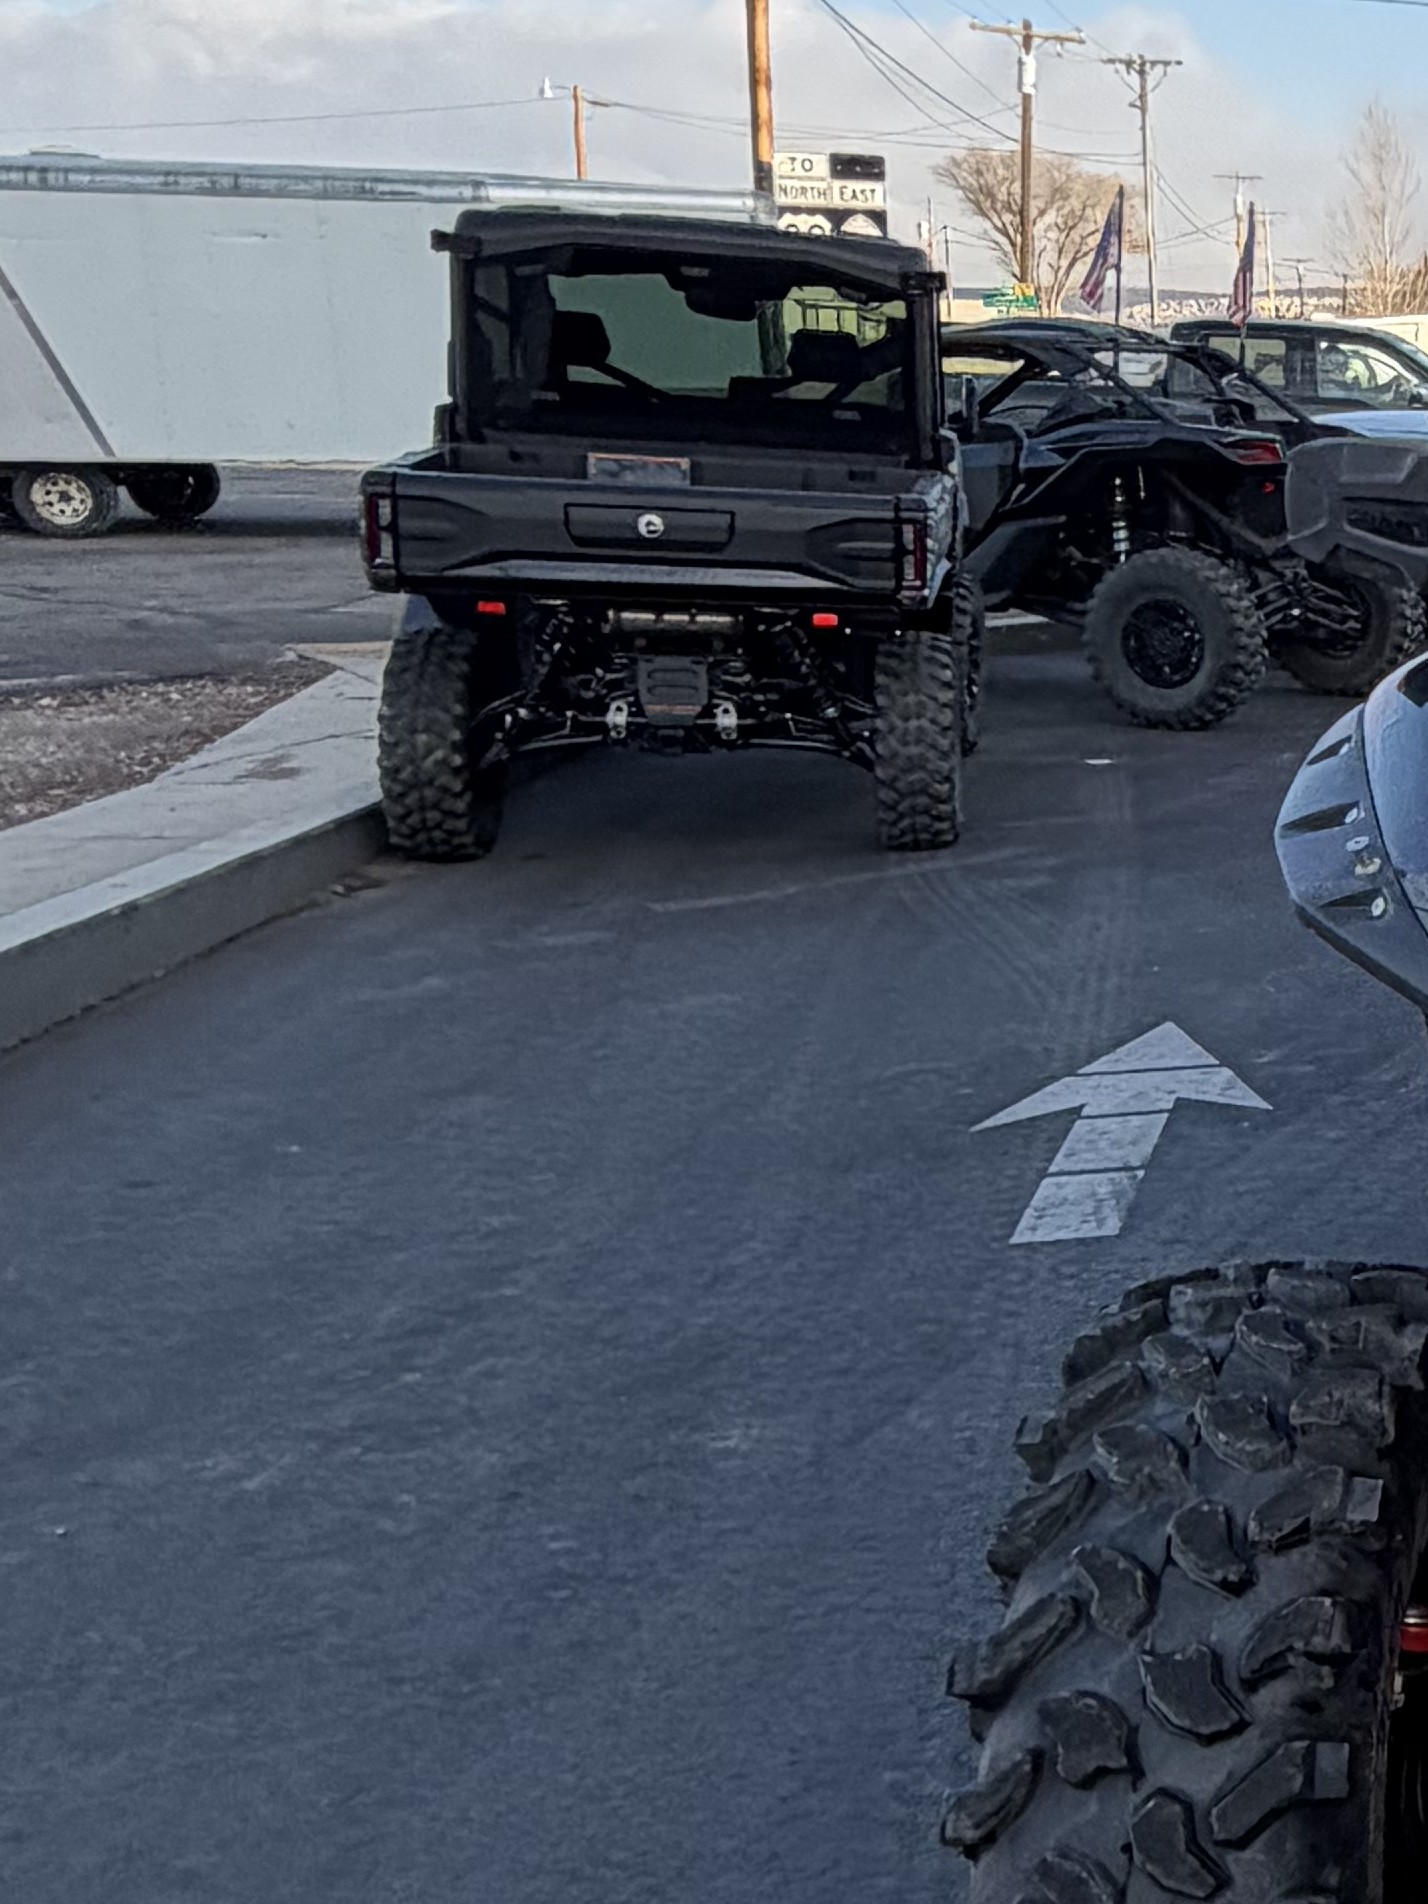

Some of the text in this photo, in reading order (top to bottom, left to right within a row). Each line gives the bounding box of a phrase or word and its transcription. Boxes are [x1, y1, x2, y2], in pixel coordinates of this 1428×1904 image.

[785, 156, 814, 173] TO
[778, 183, 828, 202] NORTH
[839, 185, 877, 203] EAST
